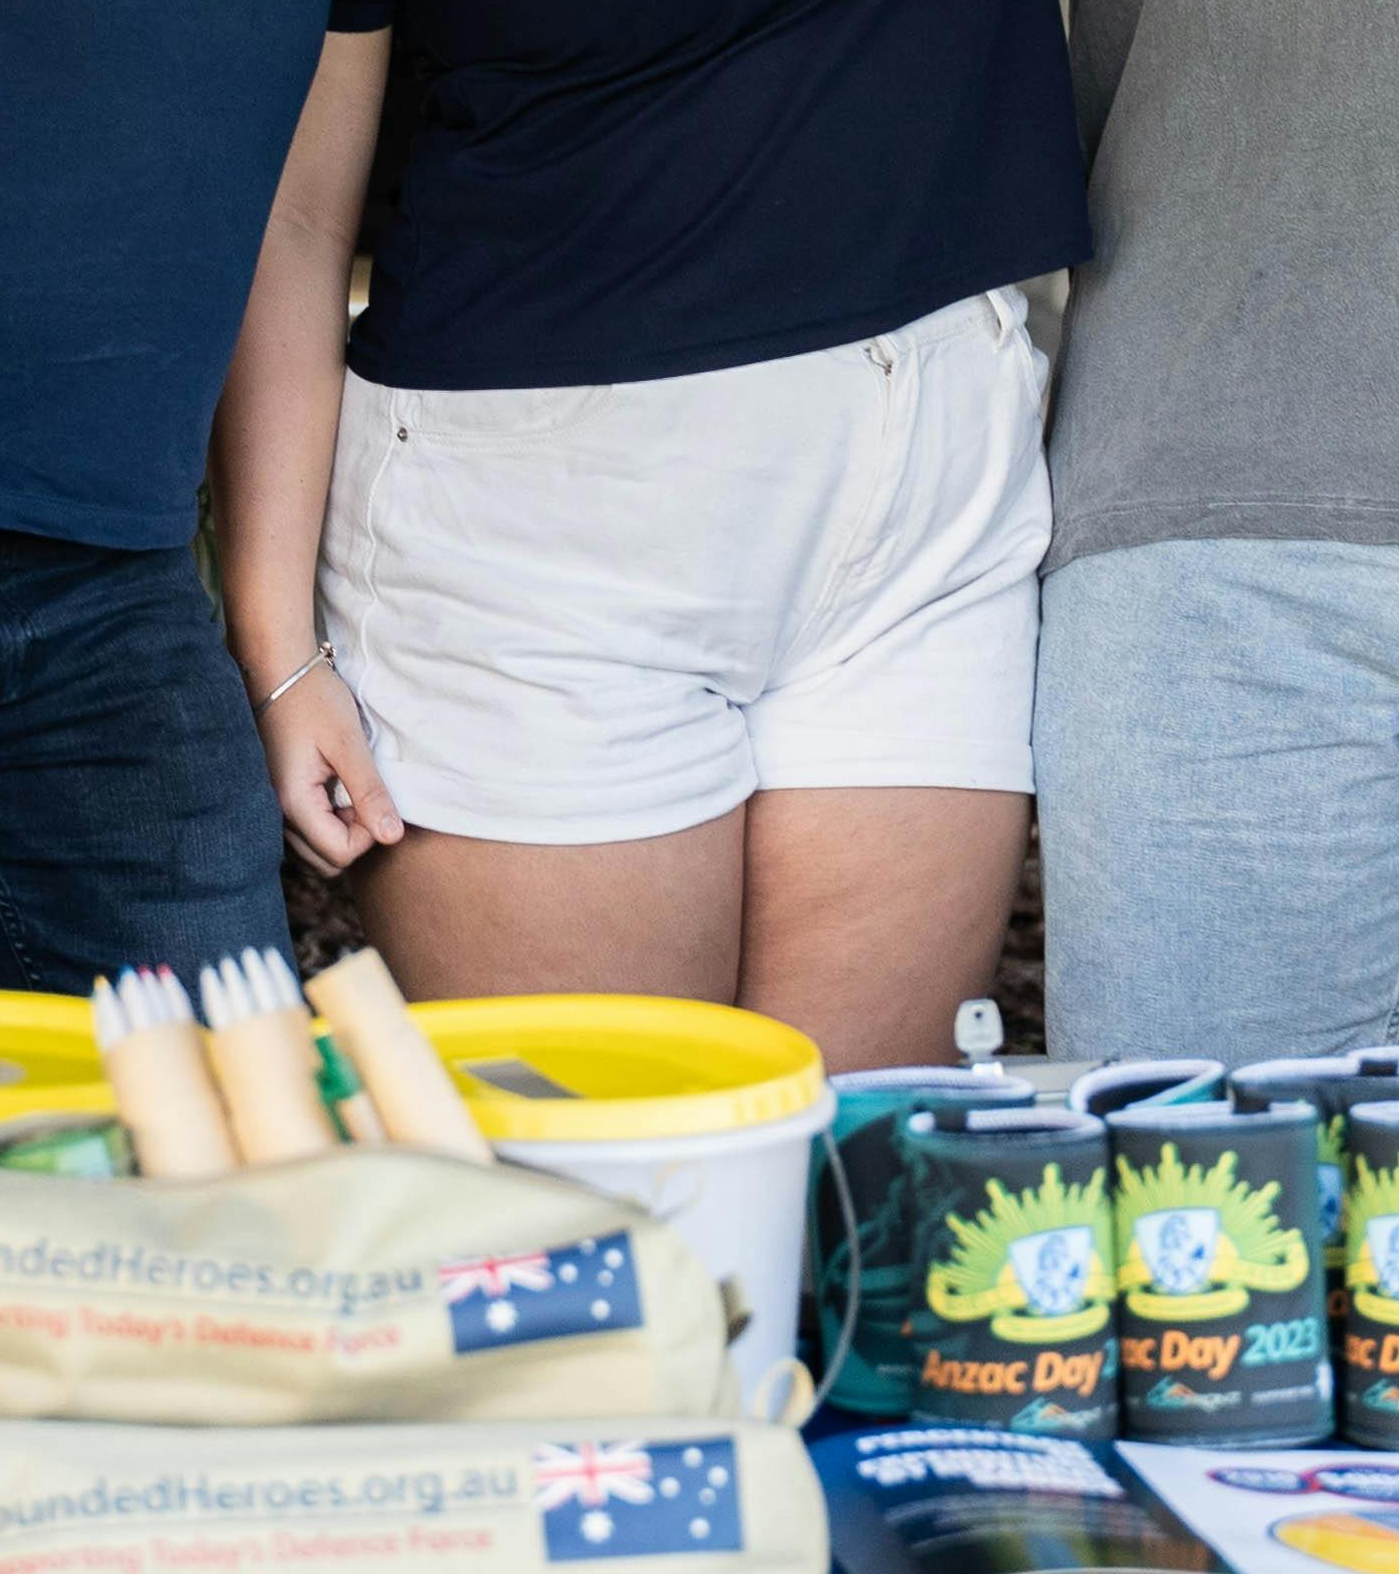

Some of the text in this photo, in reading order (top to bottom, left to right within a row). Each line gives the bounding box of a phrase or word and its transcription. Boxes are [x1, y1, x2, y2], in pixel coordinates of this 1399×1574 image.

[921, 1350, 1028, 1395] Anzac
[1033, 1351, 1103, 1398] Day
[1160, 1329, 1242, 1382] Day
[1240, 1316, 1320, 1367] 2023
